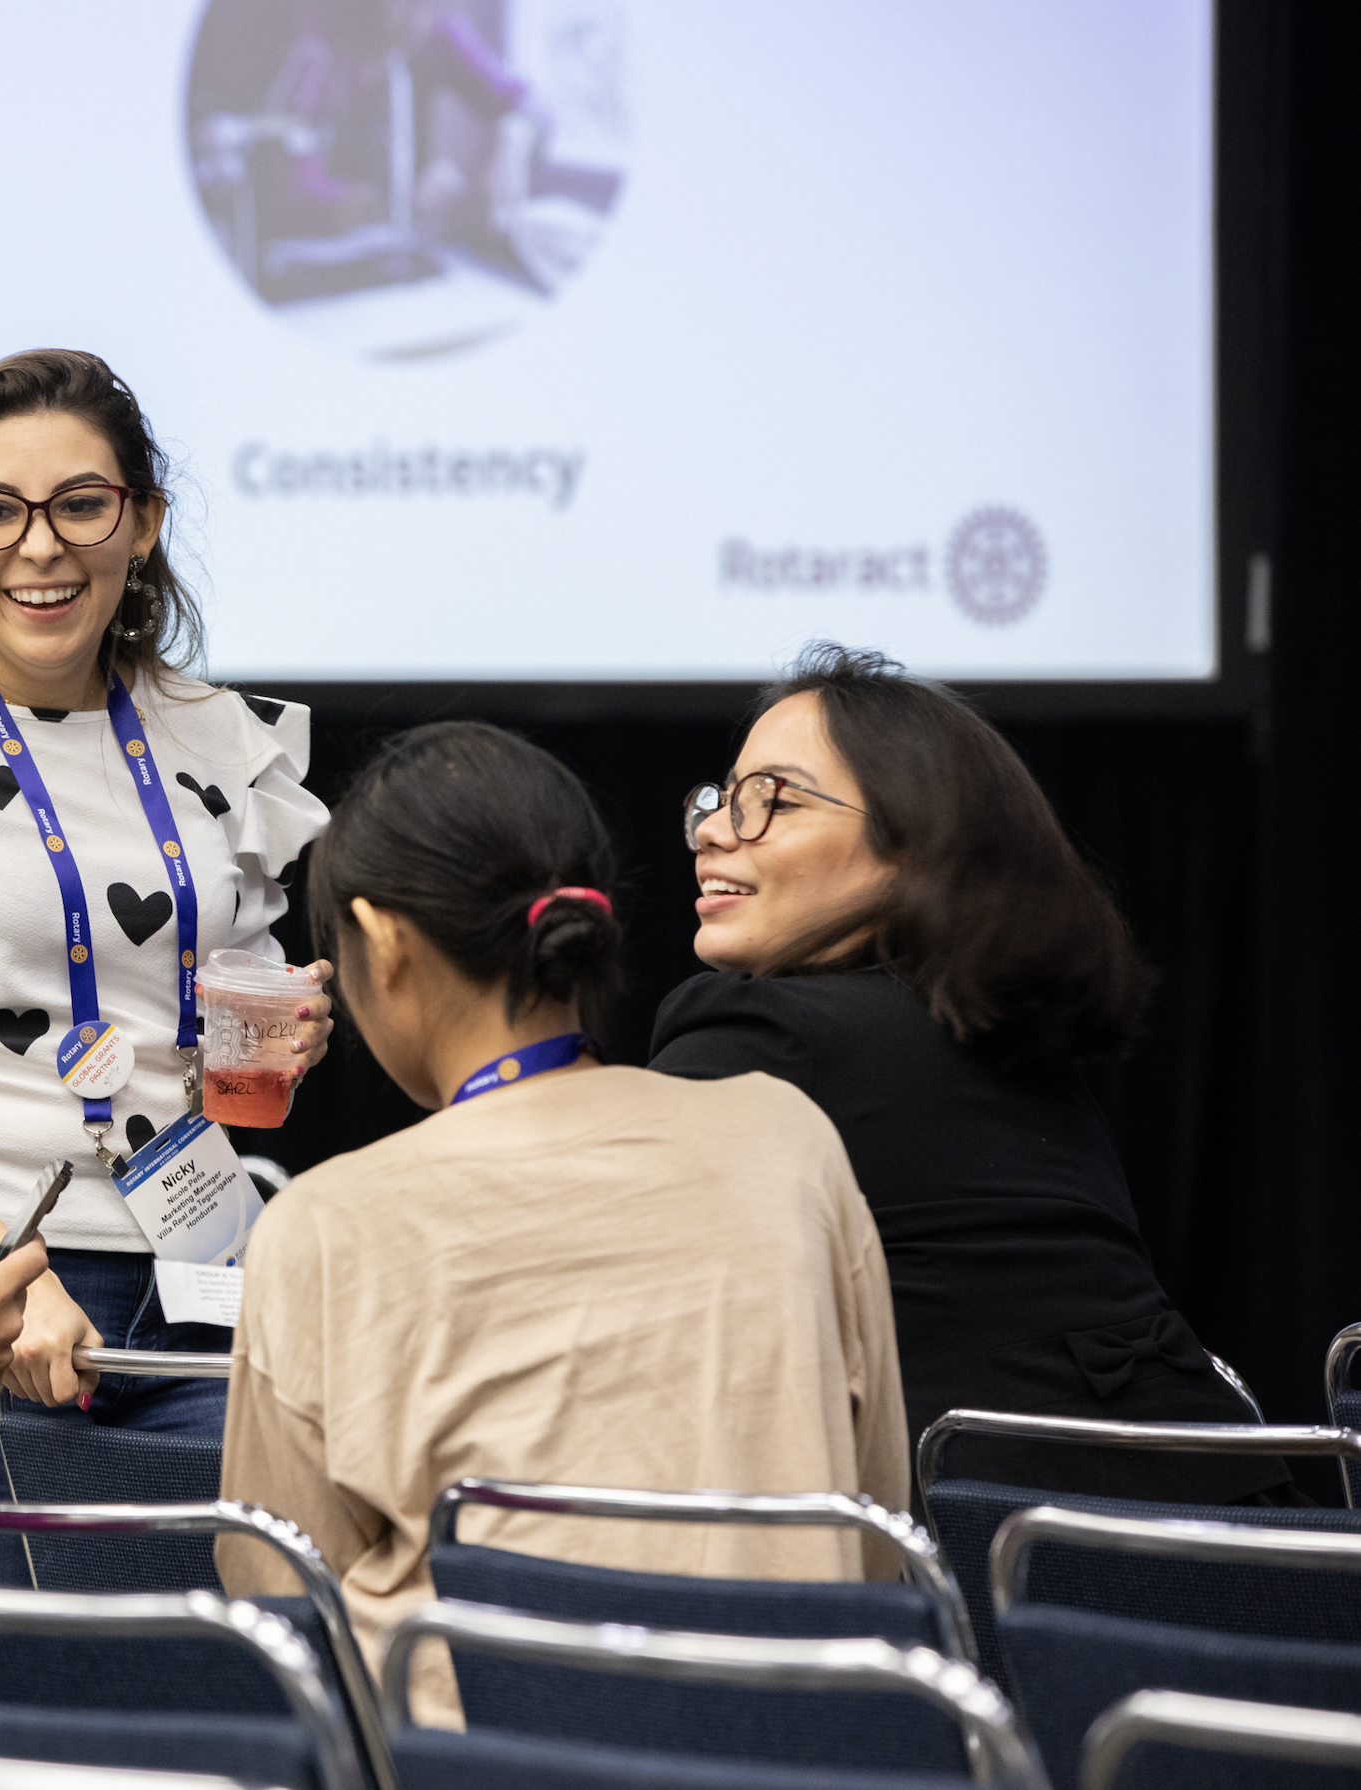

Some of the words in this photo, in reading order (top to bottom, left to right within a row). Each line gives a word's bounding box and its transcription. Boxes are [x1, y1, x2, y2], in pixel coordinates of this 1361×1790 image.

[231, 438, 589, 513] Consistency
[720, 537, 932, 593] Rotaract
[137, 758, 152, 785] Rotary
[37, 808, 54, 835] Rotary
[172, 859, 186, 887] Rotary
[72, 912, 81, 943] Rotary
[61, 1041, 83, 1063] Rotary
[72, 1063, 96, 1087] GLOBAL
[95, 1035, 120, 1062] GRANTS
[90, 1053, 117, 1083] PARTNER
[126, 1170, 144, 1187] ROTARY
[144, 1143, 178, 1173] INTERNATIONAL
[177, 1119, 206, 1145] CONVENTION
[161, 1159, 196, 1191] Nicky
[167, 1186, 188, 1205] Nicole
[188, 1170, 206, 1188] Peña
[157, 1227, 173, 1240] Villa
[172, 1213, 188, 1228] Real
[189, 1205, 197, 1215] de
[198, 1172, 237, 1206] Tegucigalpa
[161, 1194, 195, 1224] Marketing
[193, 1170, 222, 1197] Manager
[186, 1201, 218, 1230] Honduras
